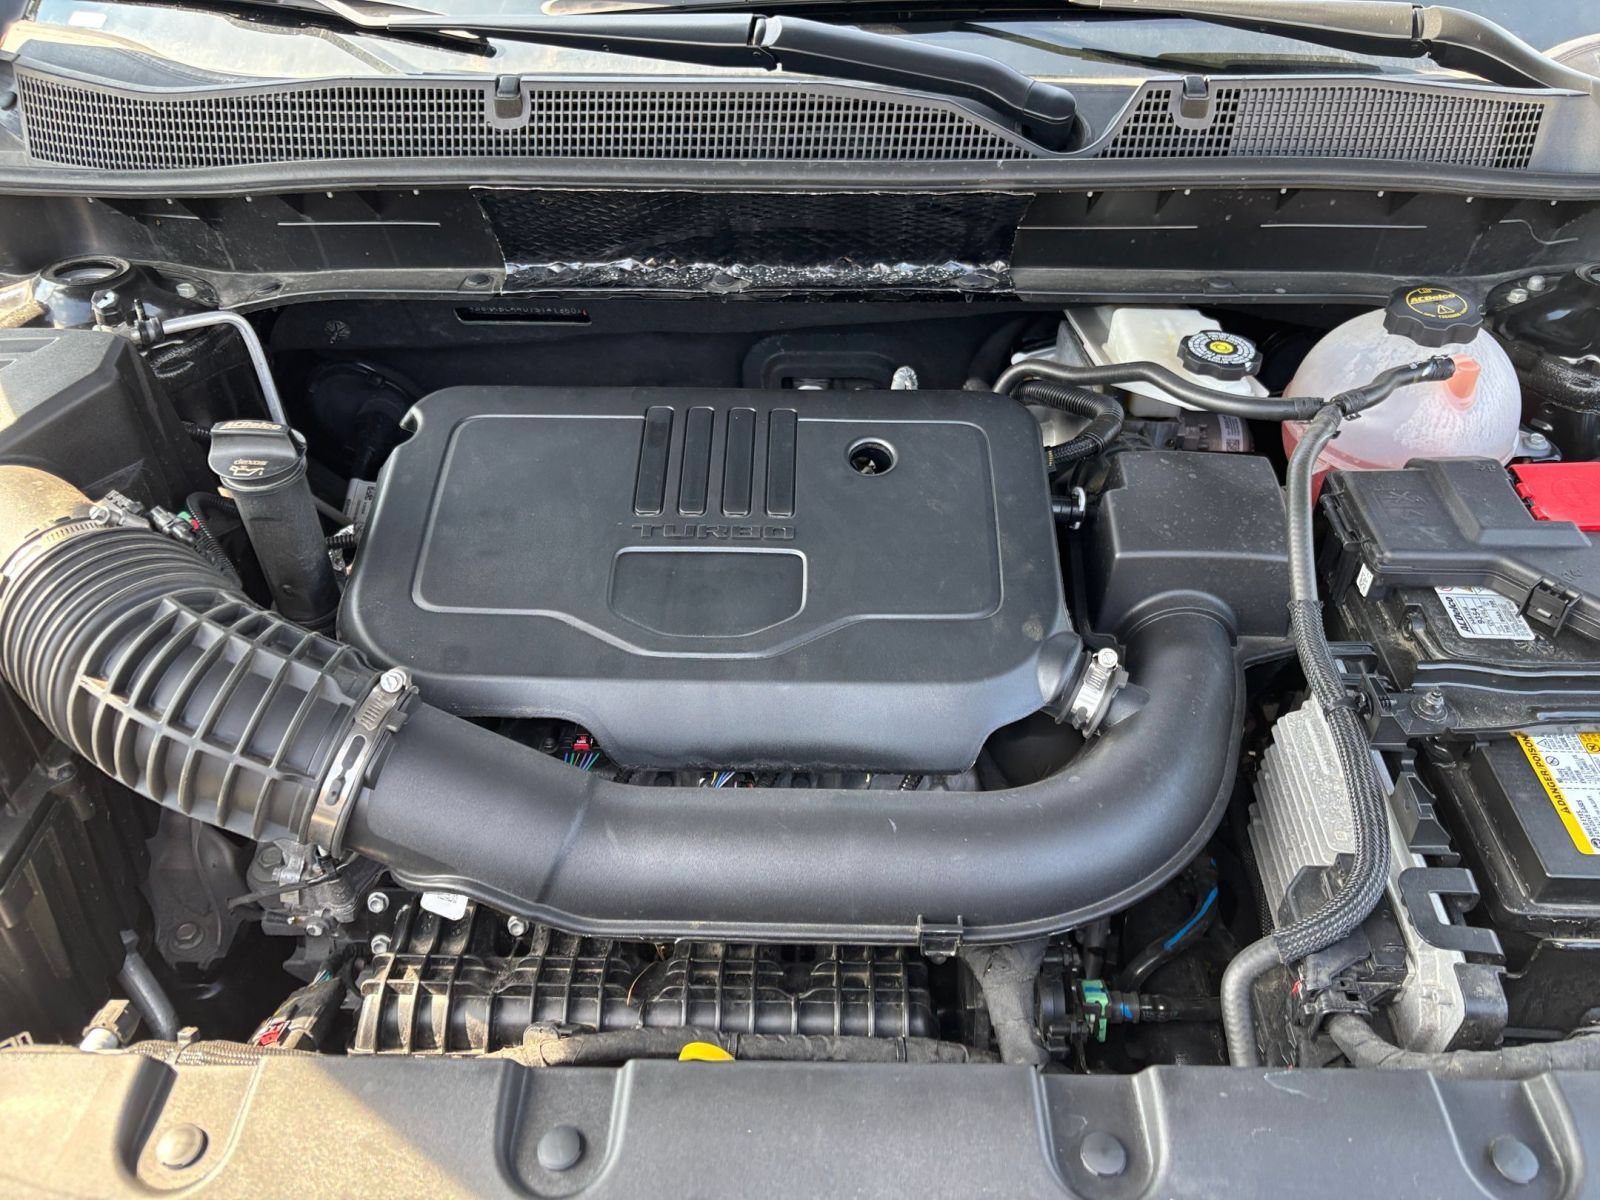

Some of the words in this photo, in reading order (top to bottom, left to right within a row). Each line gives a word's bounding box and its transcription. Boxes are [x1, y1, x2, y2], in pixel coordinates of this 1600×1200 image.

[1410, 293, 1456, 305] ACDelco
[631, 523, 796, 540] TURBO
[1445, 596, 1471, 633] ACDelco
